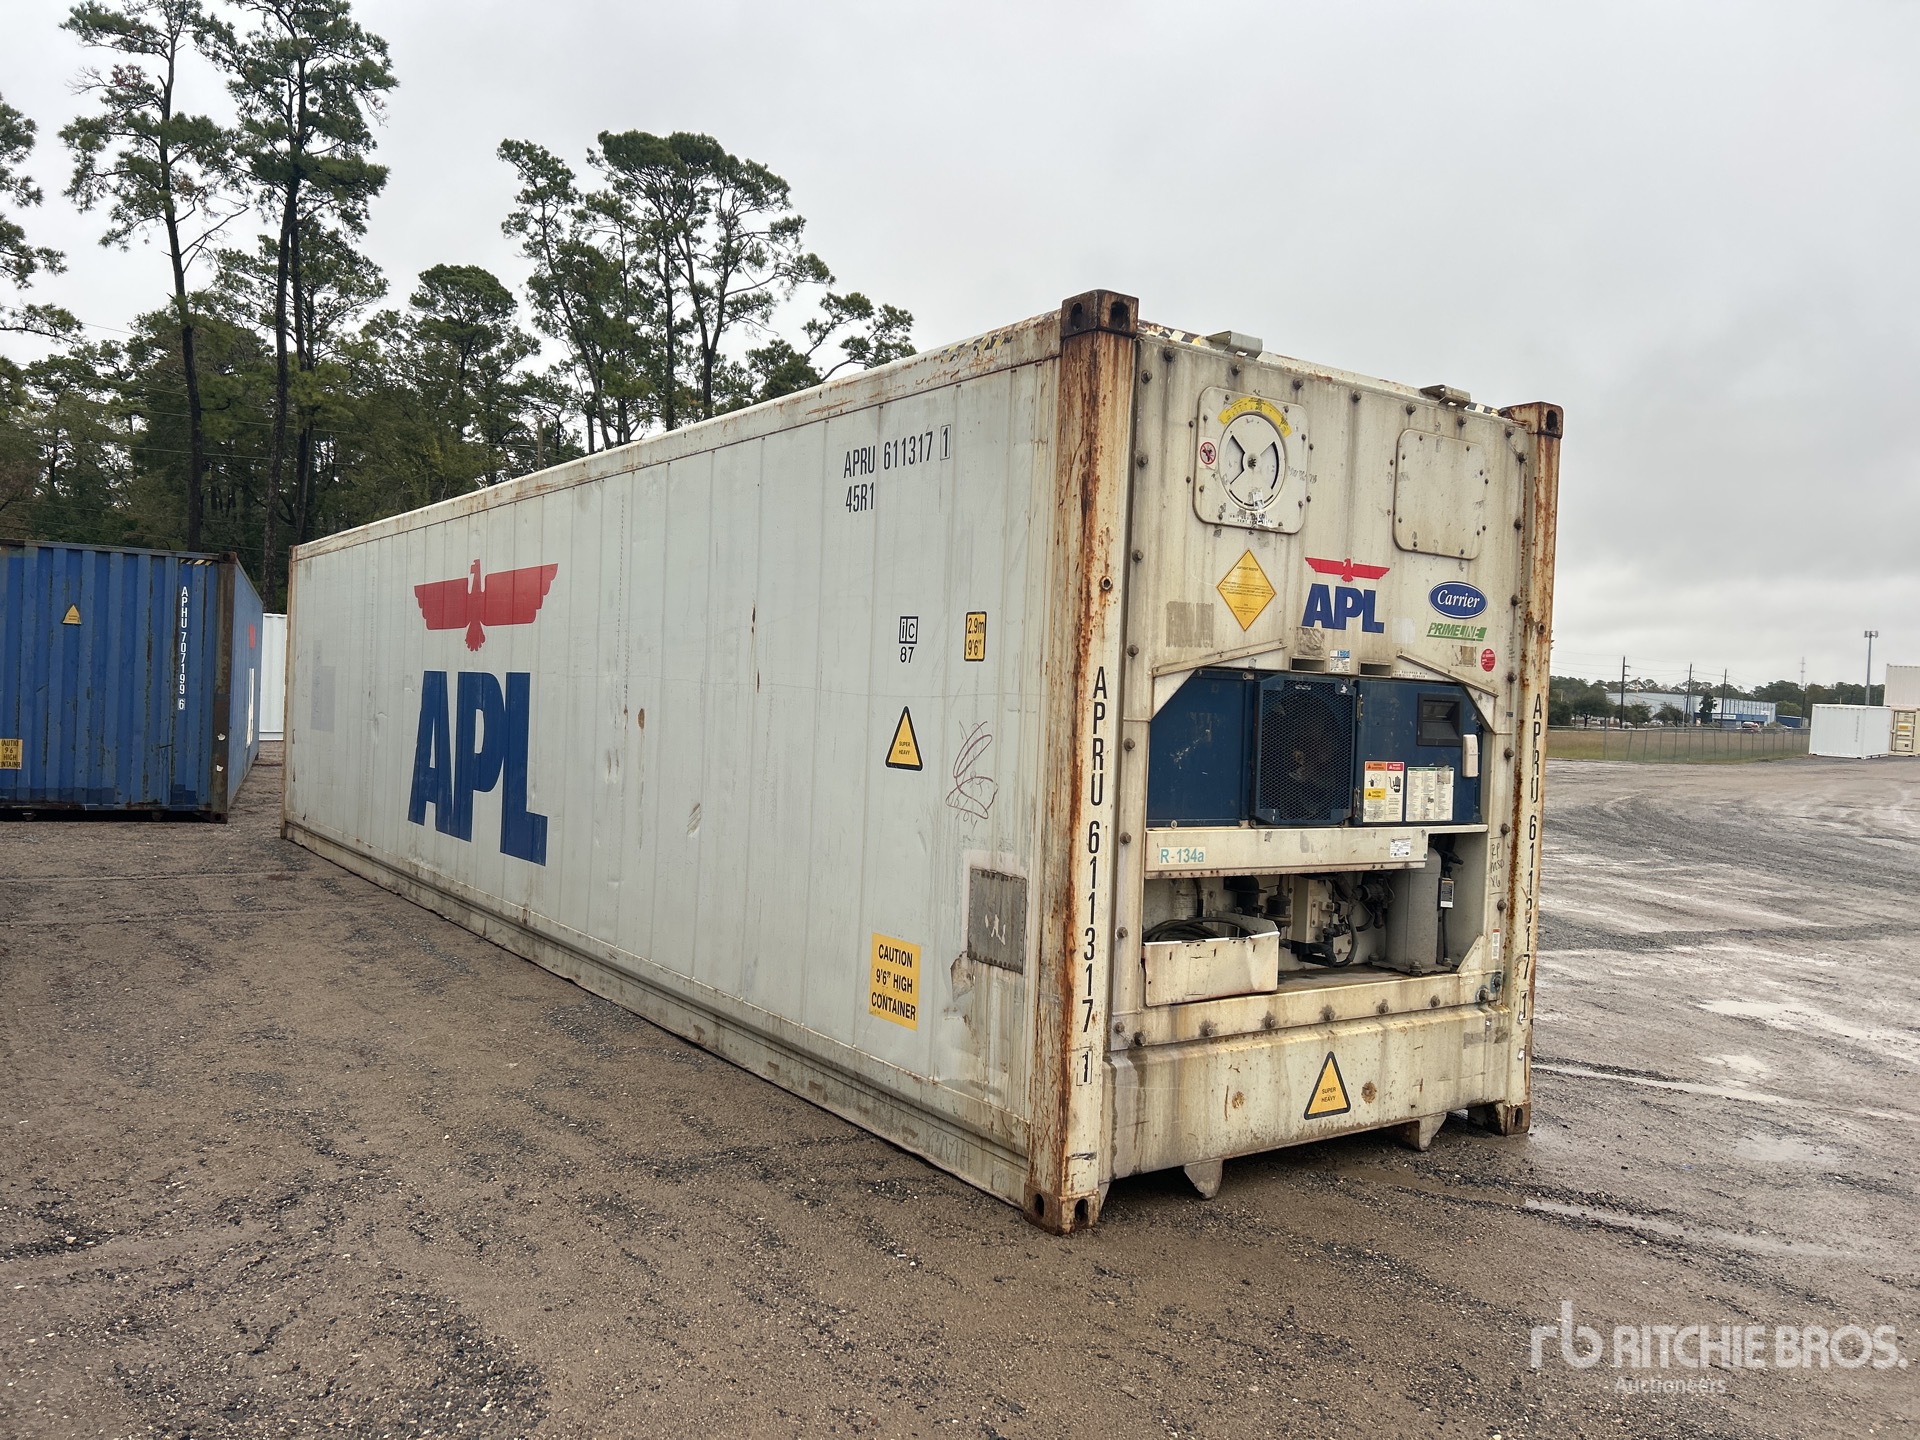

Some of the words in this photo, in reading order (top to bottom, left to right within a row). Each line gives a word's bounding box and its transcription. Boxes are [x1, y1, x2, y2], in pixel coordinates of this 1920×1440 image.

[844, 445, 876, 478] APRU
[883, 431, 933, 470] 611317
[942, 427, 949, 457] 1
[845, 482, 875, 513] 45R1
[181, 586, 189, 629] APHU
[1301, 583, 1384, 634] APL
[1437, 589, 1480, 608] Carrier
[967, 617, 985, 634] 2.9m
[179, 631, 188, 695] 707199
[900, 647, 915, 664] 87
[178, 699, 185, 710] 6
[1091, 666, 1107, 806] APRU
[1530, 693, 1542, 804] APRU
[408, 670, 548, 867] APL
[1082, 820, 1100, 1033] 611317
[878, 943, 913, 968] CAUTION
[893, 973, 913, 994] HIGH
[871, 991, 916, 1021] CONTAINER
[1321, 1086, 1337, 1095] SUPER
